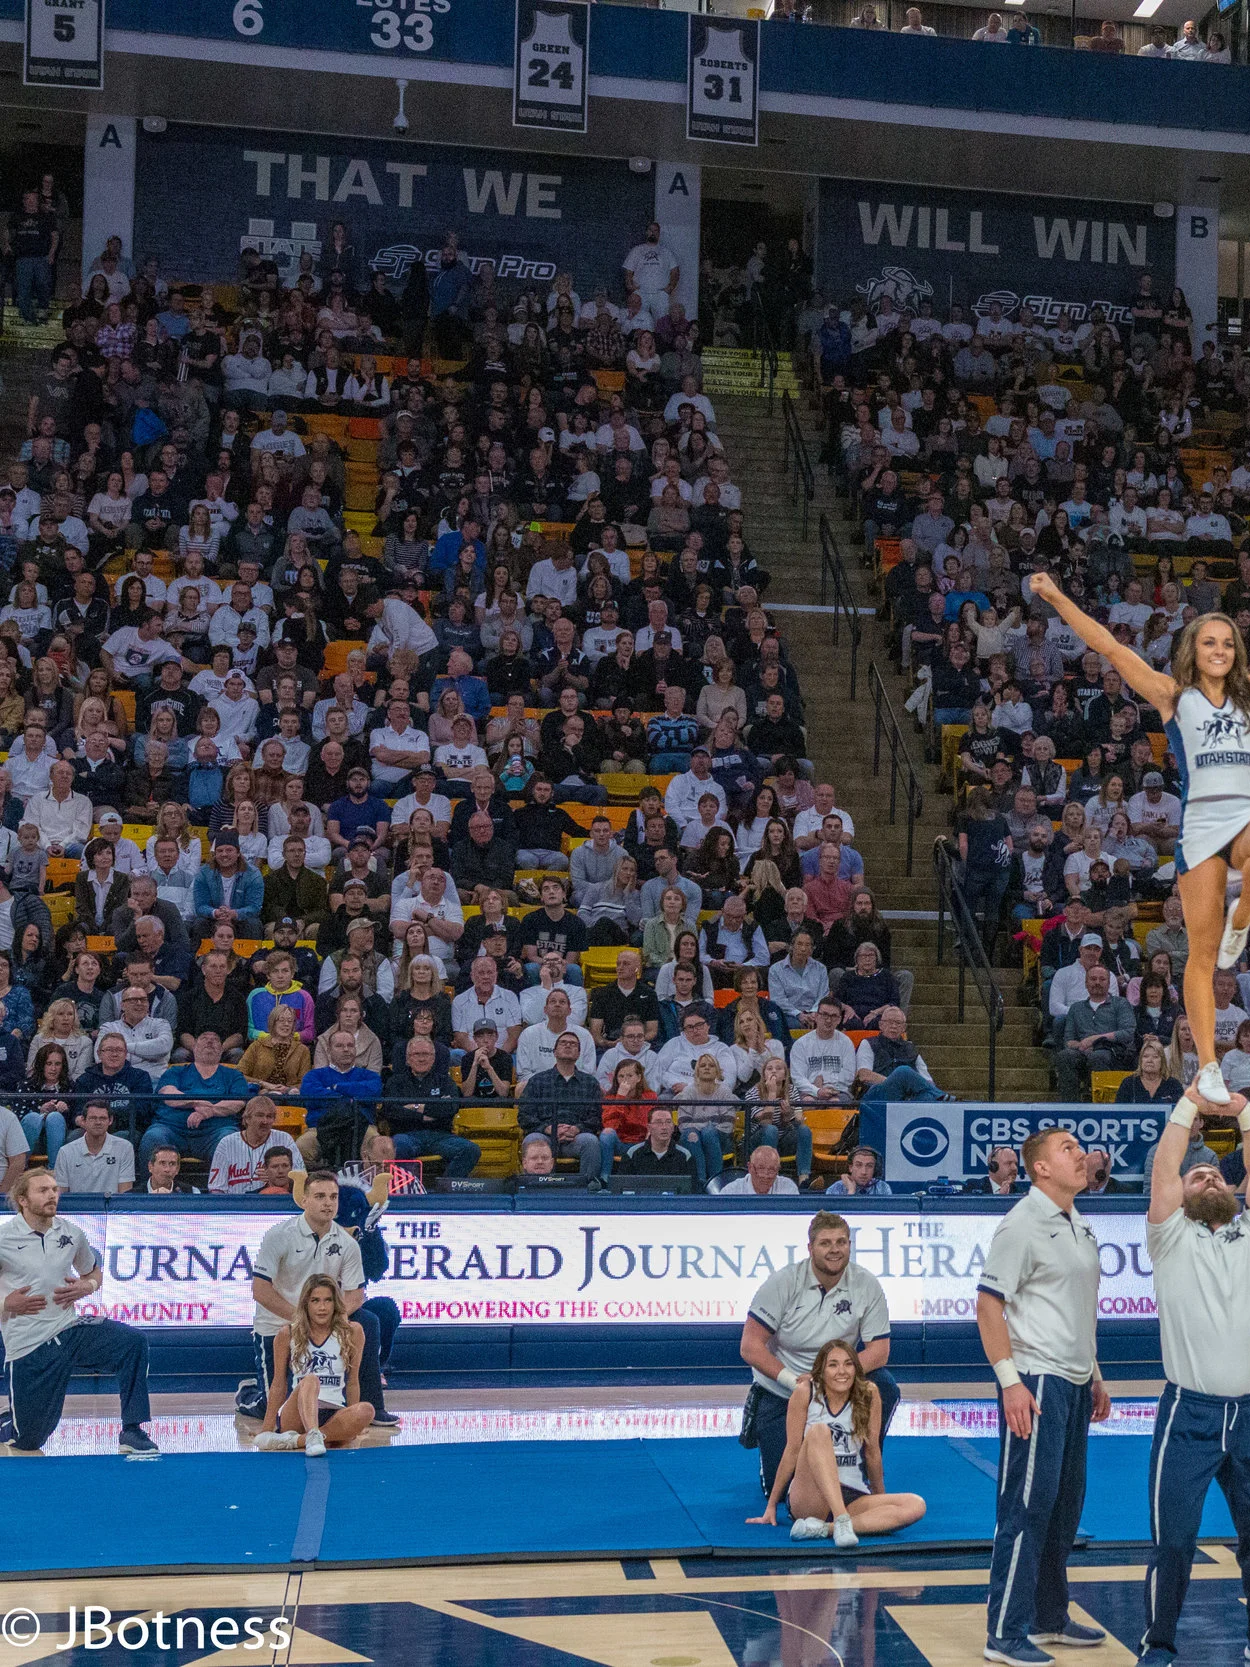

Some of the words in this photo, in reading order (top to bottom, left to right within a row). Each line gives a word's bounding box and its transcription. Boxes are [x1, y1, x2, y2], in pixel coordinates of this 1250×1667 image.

[53, 14, 76, 43] 5
[232, 0, 264, 36] 6
[370, 10, 434, 51] 33
[532, 42, 570, 55] GREEN
[527, 58, 575, 90] 24
[699, 57, 748, 72] ROBERTS
[703, 74, 742, 103] 31
[100, 123, 122, 149] A
[243, 150, 428, 208] THAT
[462, 168, 563, 219] WE
[668, 172, 690, 197] A
[857, 202, 1000, 254] WILL
[1033, 216, 1148, 267] WIN
[1190, 216, 1209, 238] B
[497, 254, 557, 280] Pro
[1022, 295, 1088, 324] Sign
[1195, 753, 1224, 769] UTAH
[536, 940, 568, 951] STATE
[969, 1117, 1030, 1142] CBS
[210, 1168, 219, 1185] 7
[228, 1162, 251, 1179] Mud
[396, 1221, 441, 1239] THE
[904, 1222, 944, 1238] THE
[90, 1244, 252, 1281] URNA
[370, 1227, 563, 1281] ERALD
[849, 1226, 986, 1278] HERA
[75, 1302, 213, 1322] OMMUNITY
[402, 1300, 550, 1319] EMPOWERING
[555, 1300, 598, 1318] THE
[604, 1300, 738, 1318] COMMUNITY
